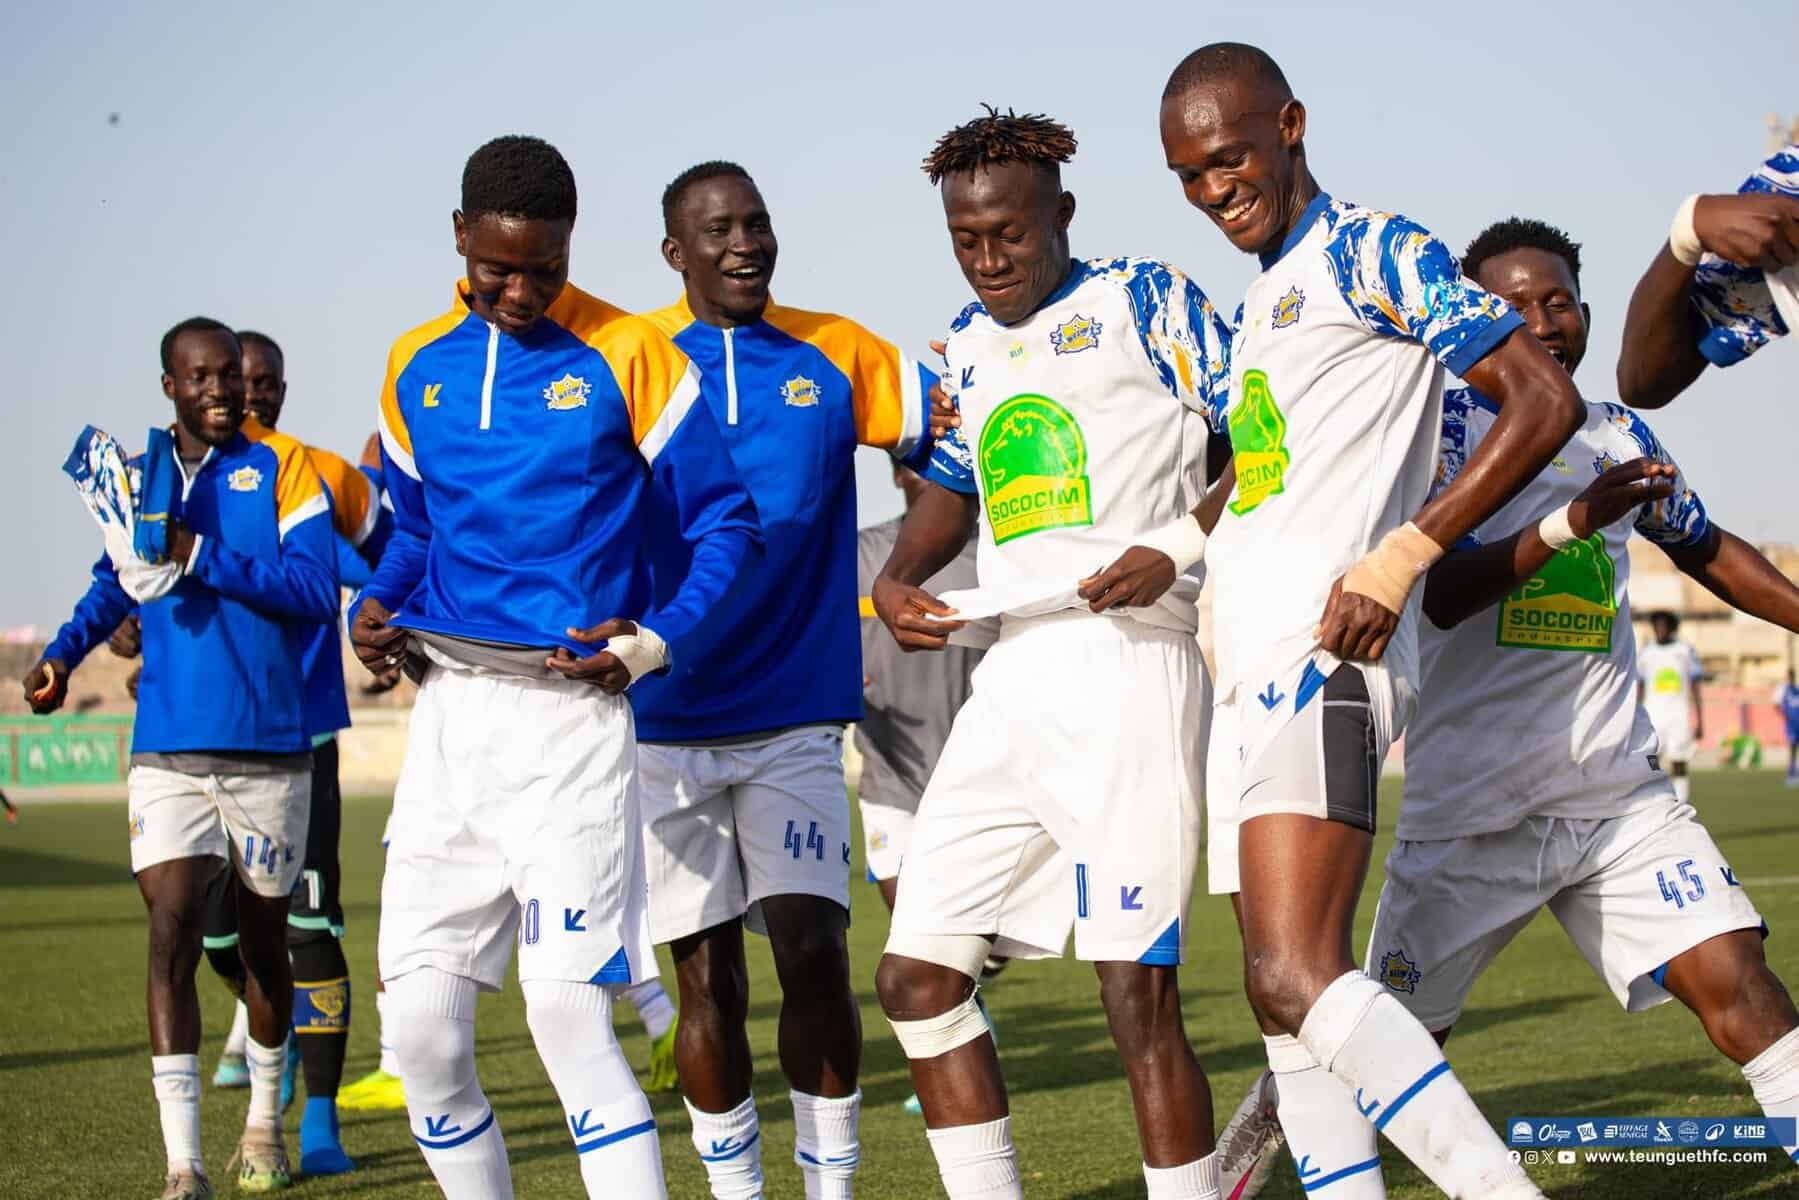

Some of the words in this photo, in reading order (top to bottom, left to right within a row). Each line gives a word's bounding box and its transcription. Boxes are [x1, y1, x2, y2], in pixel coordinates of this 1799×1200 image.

[991, 487, 1080, 521] SOCOCIM
[244, 835, 277, 875] 14
[784, 820, 824, 860] 44
[1656, 859, 1704, 909] 45
[520, 898, 540, 945] 0
